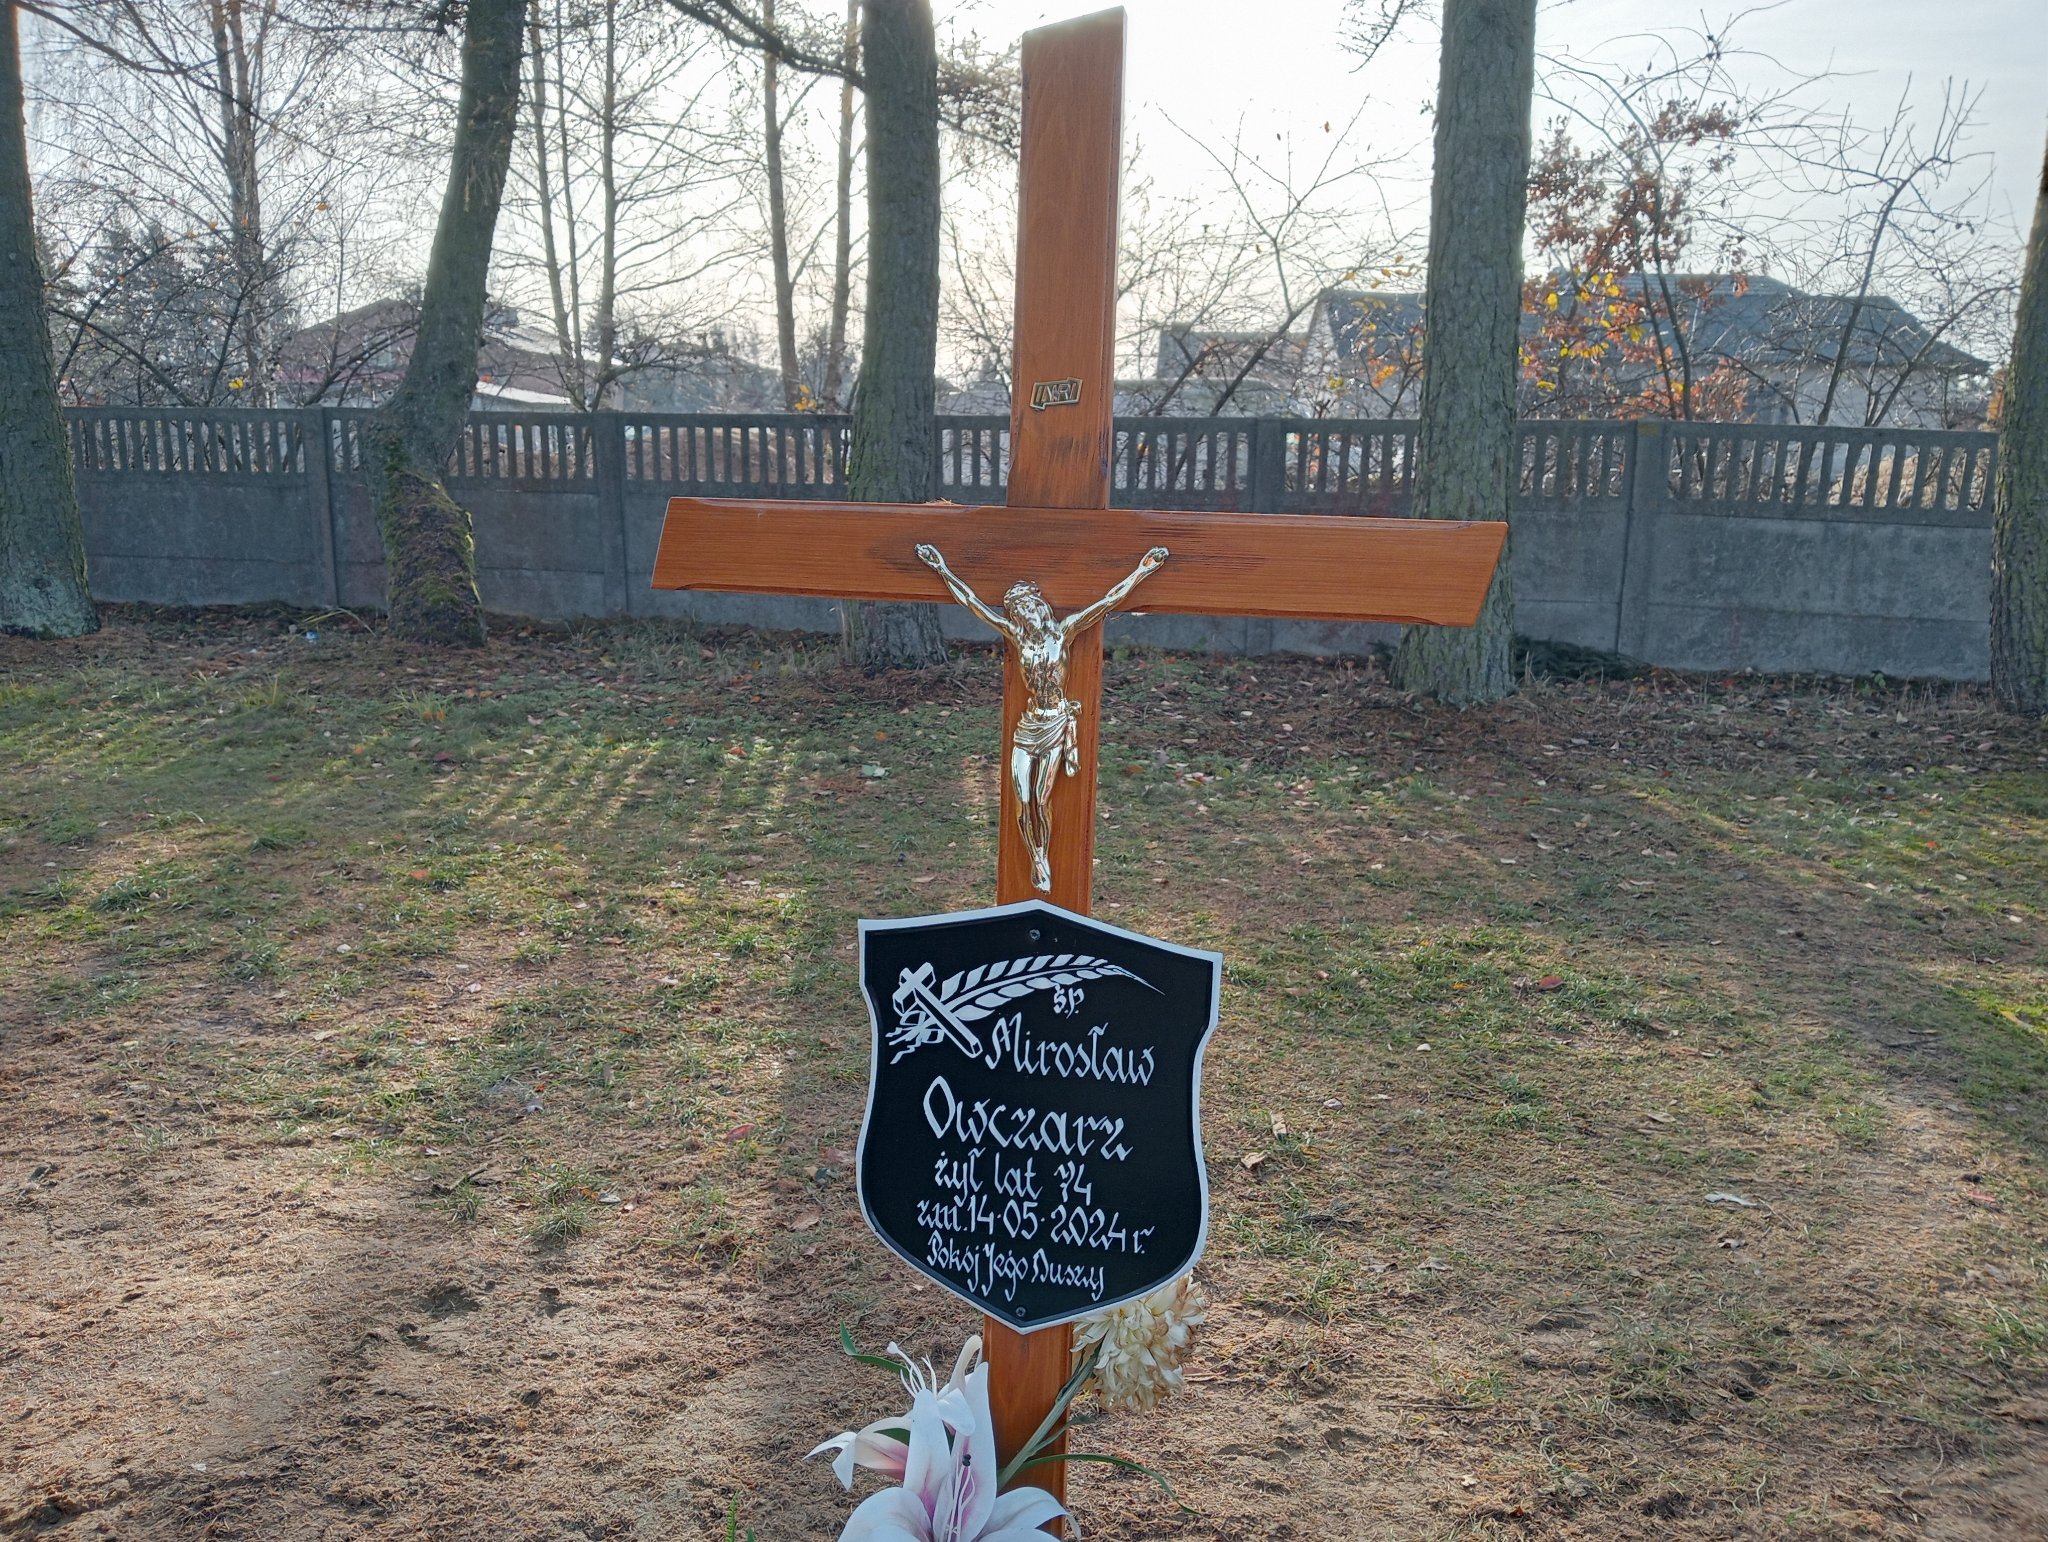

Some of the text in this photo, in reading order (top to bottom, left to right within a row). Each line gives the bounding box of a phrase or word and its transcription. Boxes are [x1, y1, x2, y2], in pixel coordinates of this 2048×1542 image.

[985, 1012, 1155, 1087] Mirosław
[923, 1075, 1134, 1162] Owczarz
[994, 1152, 1044, 1200] lat
[1053, 1159, 1093, 1206] 74
[1031, 1248, 1105, 1302] Duszy
